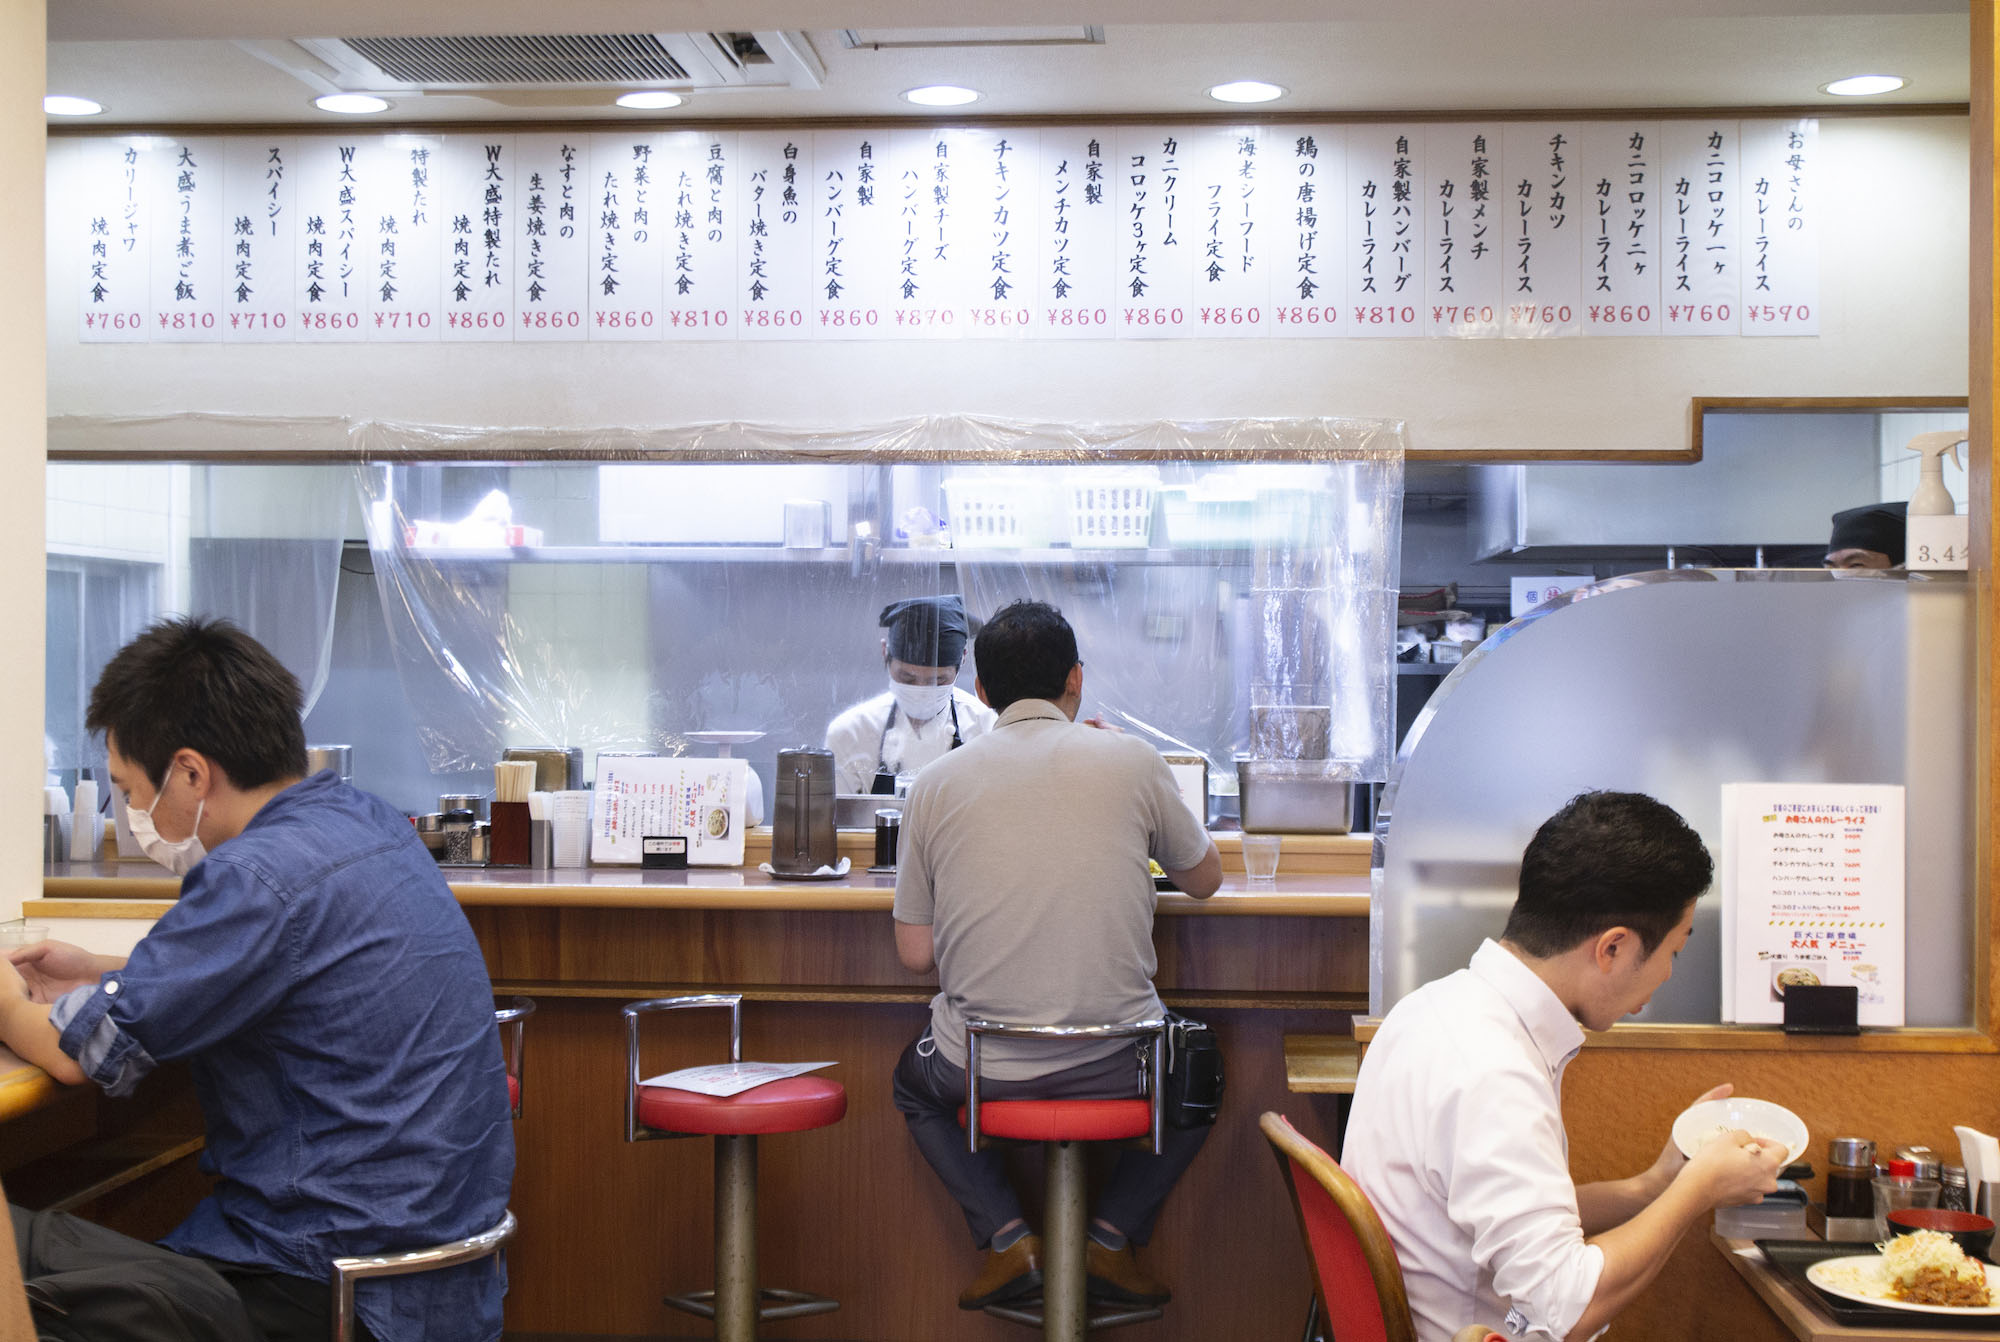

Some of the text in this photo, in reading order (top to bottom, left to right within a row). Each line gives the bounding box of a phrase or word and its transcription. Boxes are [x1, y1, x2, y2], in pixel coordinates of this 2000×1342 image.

[123, 147, 138, 252] カリージャワ
[267, 148, 283, 236] スパイシー
[411, 147, 430, 226] 特製たれ
[560, 145, 576, 238] なすと肉の
[633, 145, 652, 243] 野菜と肉の
[706, 144, 725, 242] 豆腐と肉の
[782, 143, 798, 223] 白身魚の
[857, 141, 874, 206] 自家製
[933, 141, 949, 260] 自家製チーズ
[1084, 139, 1103, 205] 自家製
[1162, 137, 1179, 245] カニクリーム
[1238, 137, 1257, 273] 海老シーフード
[1392, 136, 1412, 292] 自家製ハンバーグ
[1470, 135, 1490, 260] 自家製メンチ
[1549, 134, 1567, 229] チキンカツ
[1785, 131, 1805, 230] お母さんの
[91, 217, 109, 303] 焼肉定食
[174, 147, 197, 301] 大盛うま煮ご飯
[235, 216, 254, 303] 焼肉定食
[307, 216, 326, 302] 焼肉定食
[339, 147, 356, 297] W大盛スパイシー
[379, 215, 398, 302] 焼肉定食
[453, 214, 472, 302] 焼肉定食
[483, 145, 503, 288] W大盛特製たれ
[526, 173, 546, 302] 生姜焼き定食
[600, 172, 620, 296] たれ焼き定食
[675, 171, 694, 295] たれ焼き定食
[749, 170, 768, 301] バター焼き定食
[824, 171, 844, 300] ハンバーグ定食
[900, 171, 920, 299] ハンバーグ定食
[990, 140, 1013, 300] チキンカツ定食
[1052, 160, 1072, 299] メンチカツ定食
[1205, 185, 1225, 282] フライ定食
[1296, 136, 1319, 300] 鶏の唐揚げ定食
[1362, 181, 1376, 293] カレーライス
[1440, 180, 1454, 293] カレーライス
[1517, 179, 1532, 293] カレーライス
[1596, 178, 1611, 292] カレーライス
[1676, 177, 1690, 291] カレーライス
[1755, 178, 1770, 291] カレーライス
[86, 313, 141, 329] ¥760
[159, 312, 214, 329] ¥810
[230, 312, 286, 329] ¥710
[302, 312, 358, 329] ¥860
[374, 312, 430, 328] ¥710
[448, 312, 504, 328] ¥860
[522, 312, 579, 328] ¥860
[596, 311, 653, 327] ¥860
[670, 310, 728, 327] ¥810
[744, 310, 802, 326] ¥860
[820, 310, 878, 326] ¥860
[896, 309, 953, 325] ¥870
[971, 309, 1029, 325] ¥860
[1048, 309, 1106, 326] ¥860
[1124, 308, 1183, 325] ¥860
[1201, 307, 1260, 324] ¥860
[1277, 307, 1336, 324] ¥860
[1355, 306, 1415, 324] ¥810
[1432, 306, 1493, 323] ¥760
[1511, 305, 1571, 323] ¥760
[1589, 305, 1650, 323] ¥860
[1669, 305, 1730, 322] ¥760
[1748, 305, 1810, 322] ¥590
[1790, 940, 1867, 950] 大人気 メニュー
